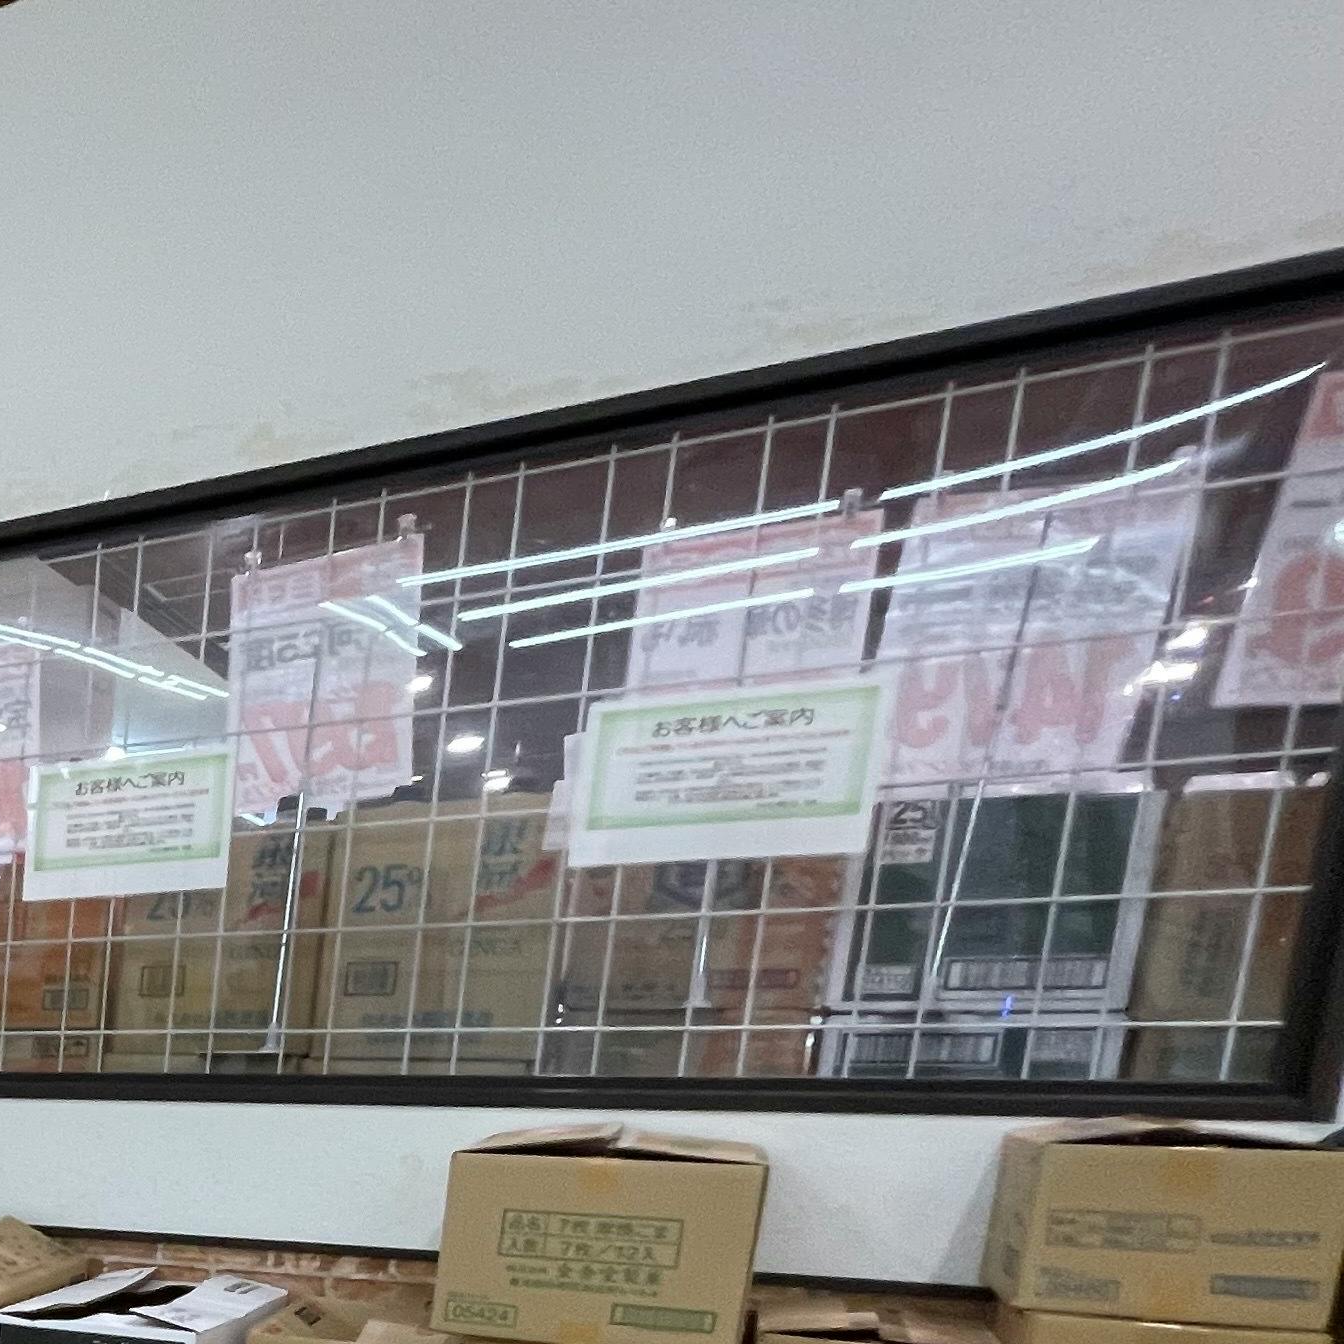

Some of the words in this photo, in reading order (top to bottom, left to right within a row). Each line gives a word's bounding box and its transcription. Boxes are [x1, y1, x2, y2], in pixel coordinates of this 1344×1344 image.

[652, 708, 815, 738] お客様へご案内
[75, 771, 185, 796] お客様へご案内
